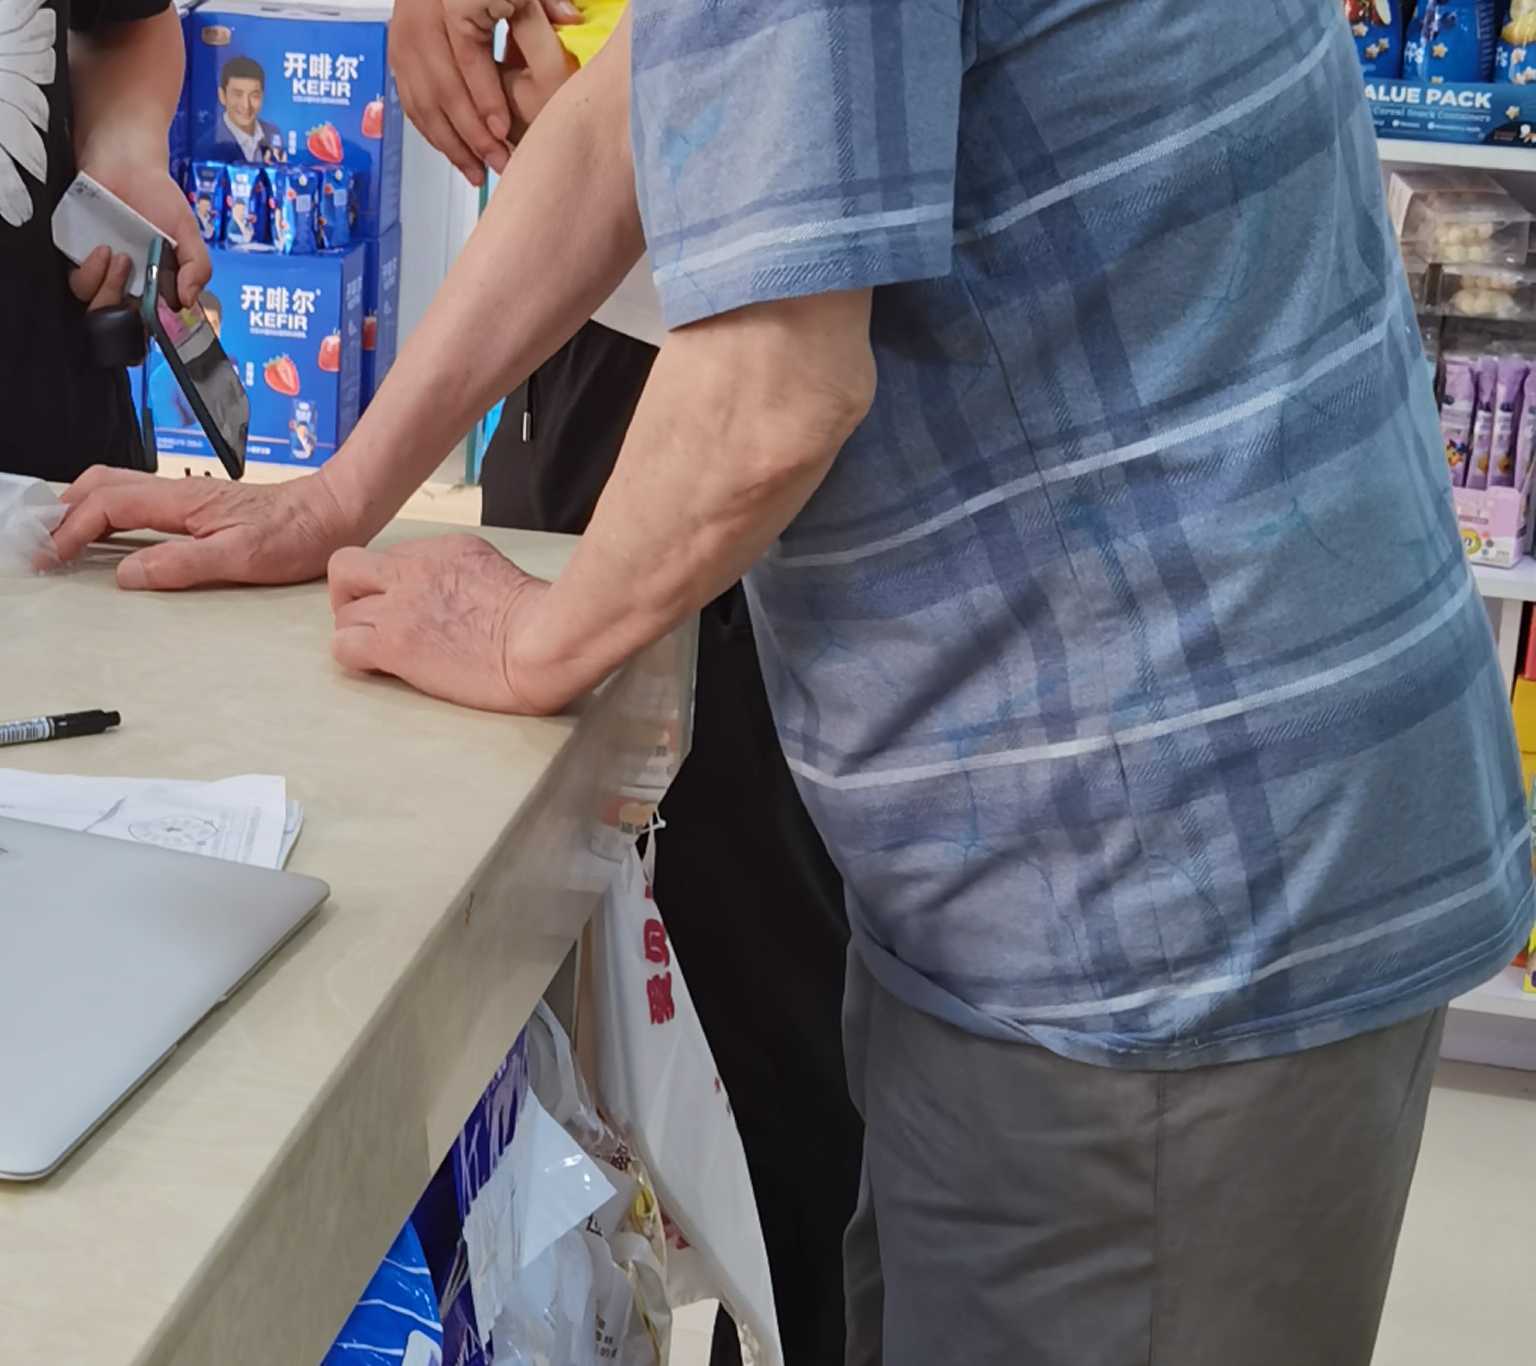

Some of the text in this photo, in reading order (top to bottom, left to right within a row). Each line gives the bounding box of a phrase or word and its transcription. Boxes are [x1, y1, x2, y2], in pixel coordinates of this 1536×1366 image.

[282, 51, 359, 81] 开啡尔
[291, 79, 352, 98] KEFIR
[1364, 84, 1493, 109] ALUE PACK
[240, 284, 316, 314] 开啡尔
[249, 311, 309, 331] KEFIR
